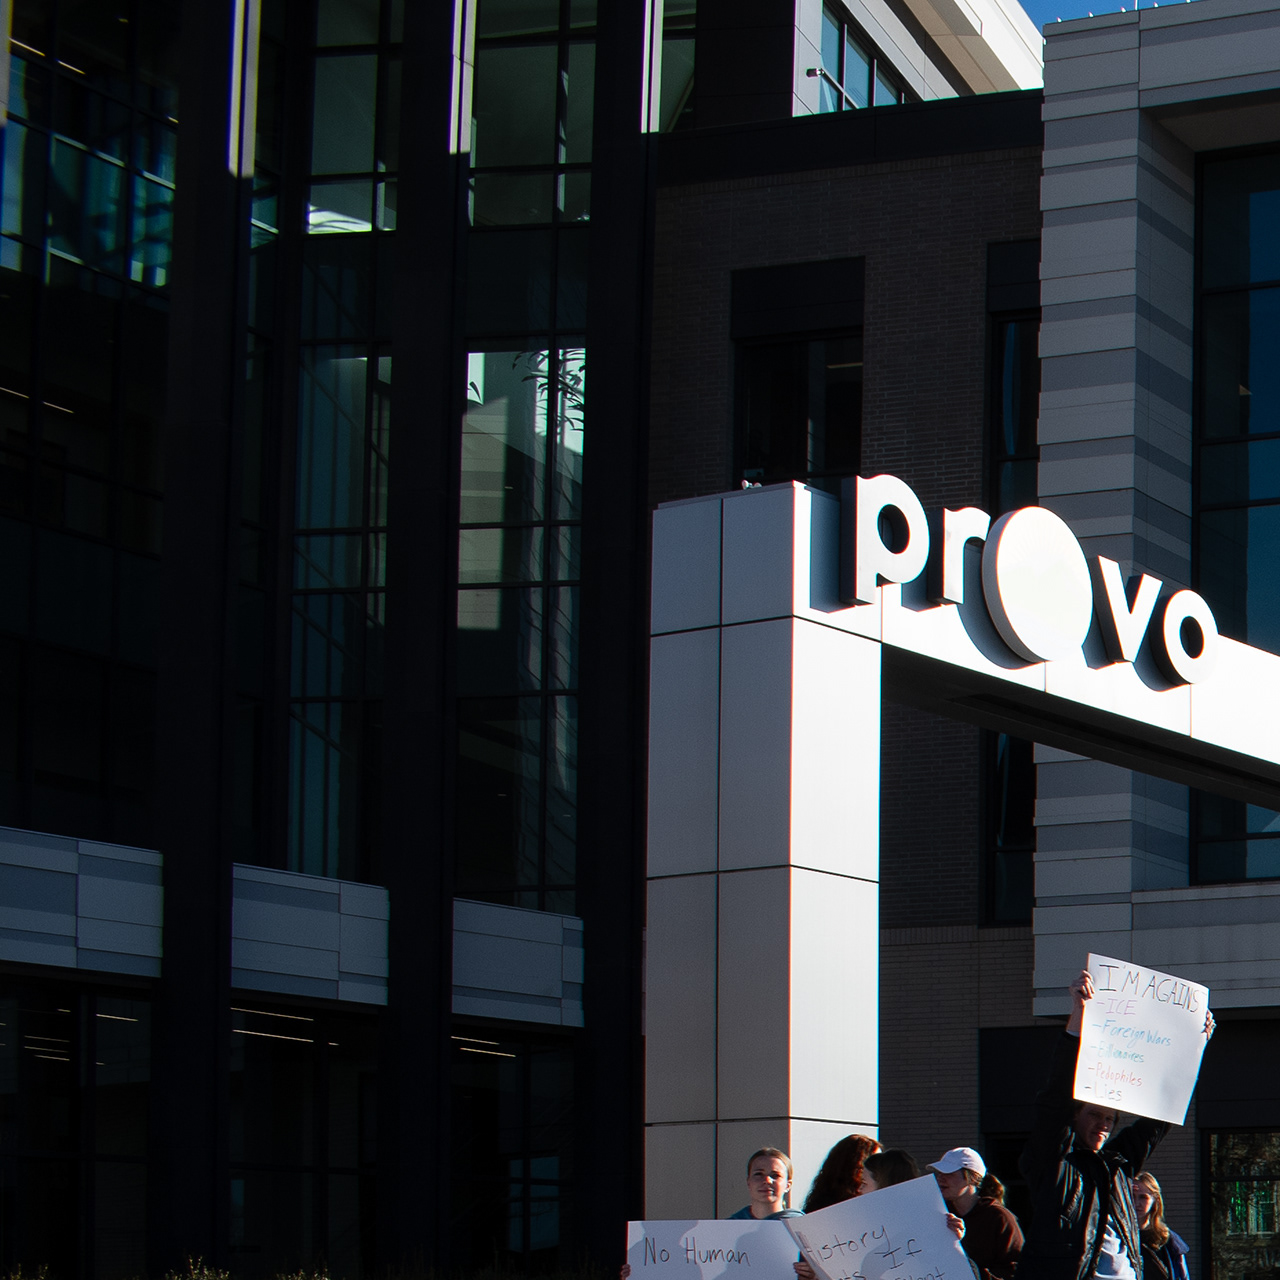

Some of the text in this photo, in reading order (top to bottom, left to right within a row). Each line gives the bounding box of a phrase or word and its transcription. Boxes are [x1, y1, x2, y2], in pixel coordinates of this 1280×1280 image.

[1098, 963, 1141, 996] I'M
[1146, 1027, 1172, 1047] Wars
[643, 1236, 751, 1266] No Human
[882, 1238, 923, 1270] If
